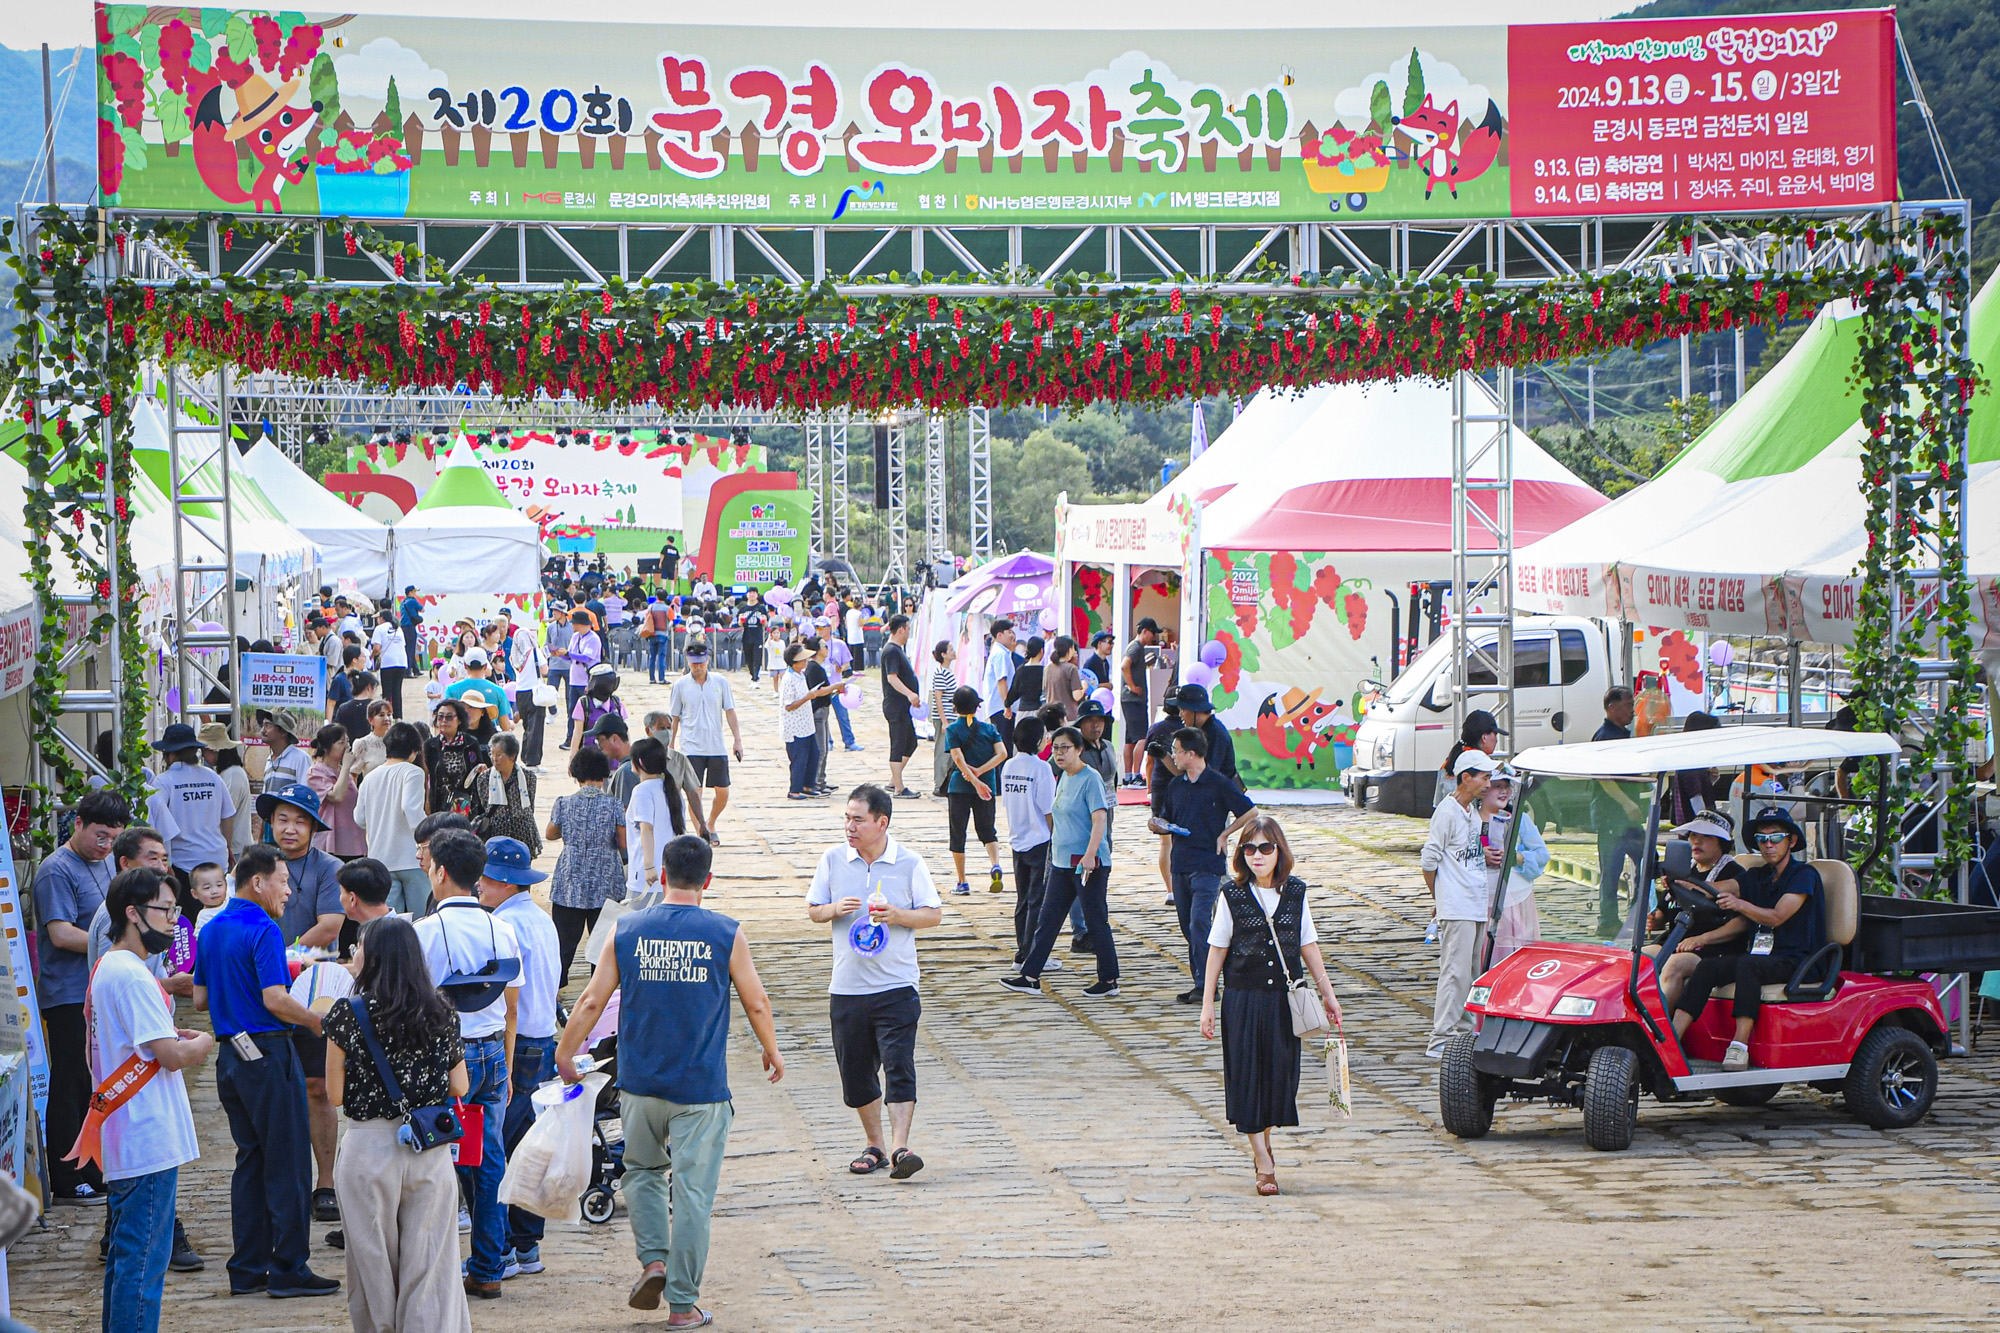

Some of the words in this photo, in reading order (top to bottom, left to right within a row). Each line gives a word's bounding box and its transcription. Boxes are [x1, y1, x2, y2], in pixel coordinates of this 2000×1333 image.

[1568, 39, 1633, 63] 다섯가지
[1635, 37, 1669, 63] 맛의
[427, 85, 634, 135] 제20회
[1592, 117, 1643, 142] 문경시
[1647, 115, 1698, 141] 동로면
[1702, 113, 1770, 138] 금천둔치
[1774, 110, 1809, 135] 일원
[1533, 159, 1570, 178] 9.13.
[1574, 156, 1600, 178] (금)
[1604, 154, 1664, 175] 축하공연
[1688, 152, 1735, 175] 박서진,
[1739, 149, 1787, 172] 마이진,
[1791, 147, 1839, 168] 윤태화,
[1843, 144, 1875, 166] 영기
[1533, 186, 1571, 205] 9.14.
[1575, 183, 1601, 205] (토)
[1604, 180, 1664, 202] 축하공연
[1688, 179, 1735, 201] 정서주,
[1739, 177, 1773, 199] 주미,
[1777, 175, 1826, 197] 윤윤서,
[1830, 172, 1875, 192] 박미영
[563, 191, 596, 205] 문경시
[608, 191, 771, 210] 문경오미자축제추진위원회
[482, 459, 535, 471] 제20회
[747, 540, 780, 553] 경찰과
[736, 554, 791, 568] 문경시민은
[736, 570, 792, 582] 하나입니다
[1231, 571, 1259, 582] 2024
[1231, 585, 1259, 595] Omija
[1647, 574, 1671, 607] 오미자
[1718, 578, 1746, 613] 체험장
[1231, 594, 1260, 602] Festival
[1822, 583, 1854, 621] 오미자
[252, 673, 287, 684] 사탕수수
[289, 675, 315, 685] 100%
[252, 684, 285, 696] 비정제
[287, 685, 314, 698] 원당!
[1004, 783, 1028, 794] STAFF
[182, 790, 213, 802] STAFF
[639, 956, 671, 970] SPORTS
[671, 957, 680, 970] is
[680, 957, 694, 968] MY
[638, 968, 680, 982] ATHLETIC
[679, 966, 708, 983] CLUB
